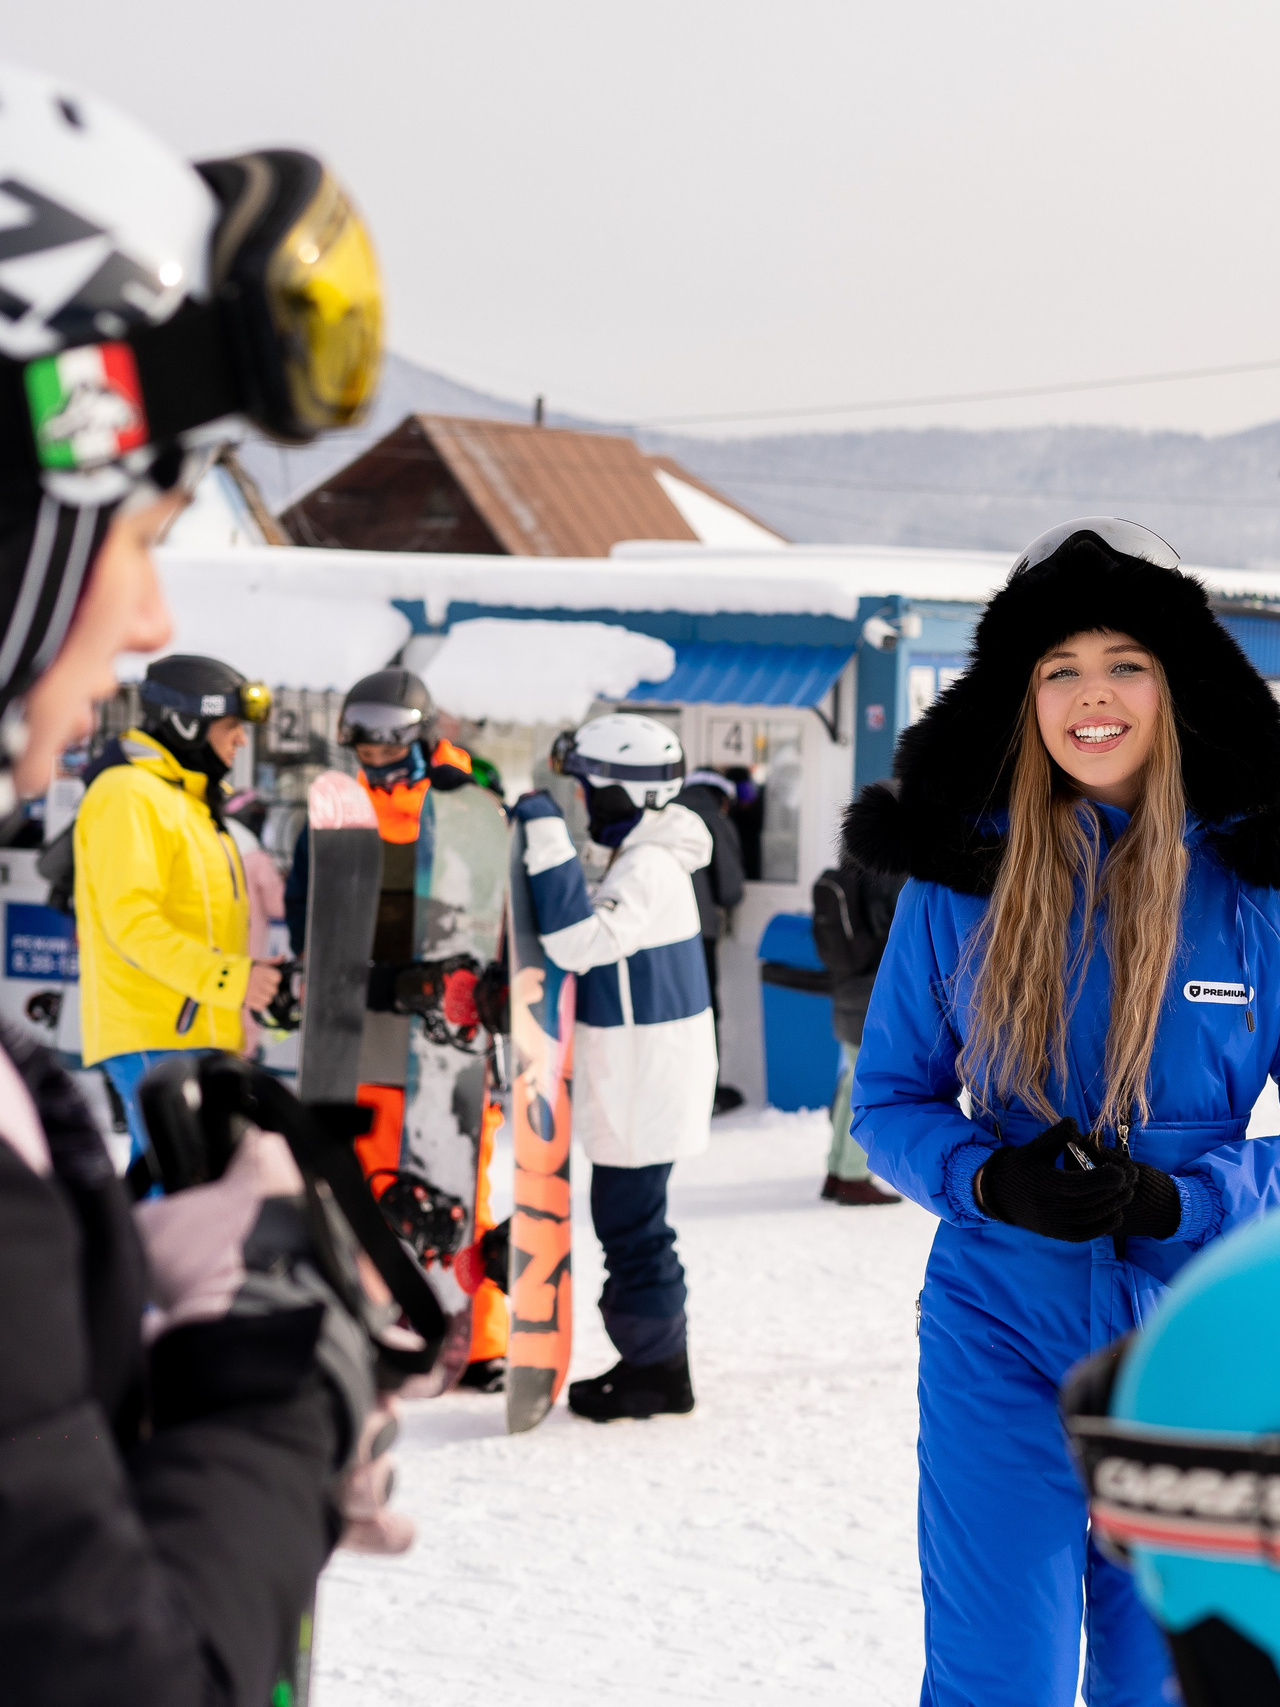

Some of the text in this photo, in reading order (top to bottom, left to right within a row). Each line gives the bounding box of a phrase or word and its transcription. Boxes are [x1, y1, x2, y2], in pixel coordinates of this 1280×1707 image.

[281, 710, 297, 739] 2
[722, 720, 743, 756] 4
[1203, 988, 1247, 998] PREMIUM
[509, 1040, 573, 1404] OINT
